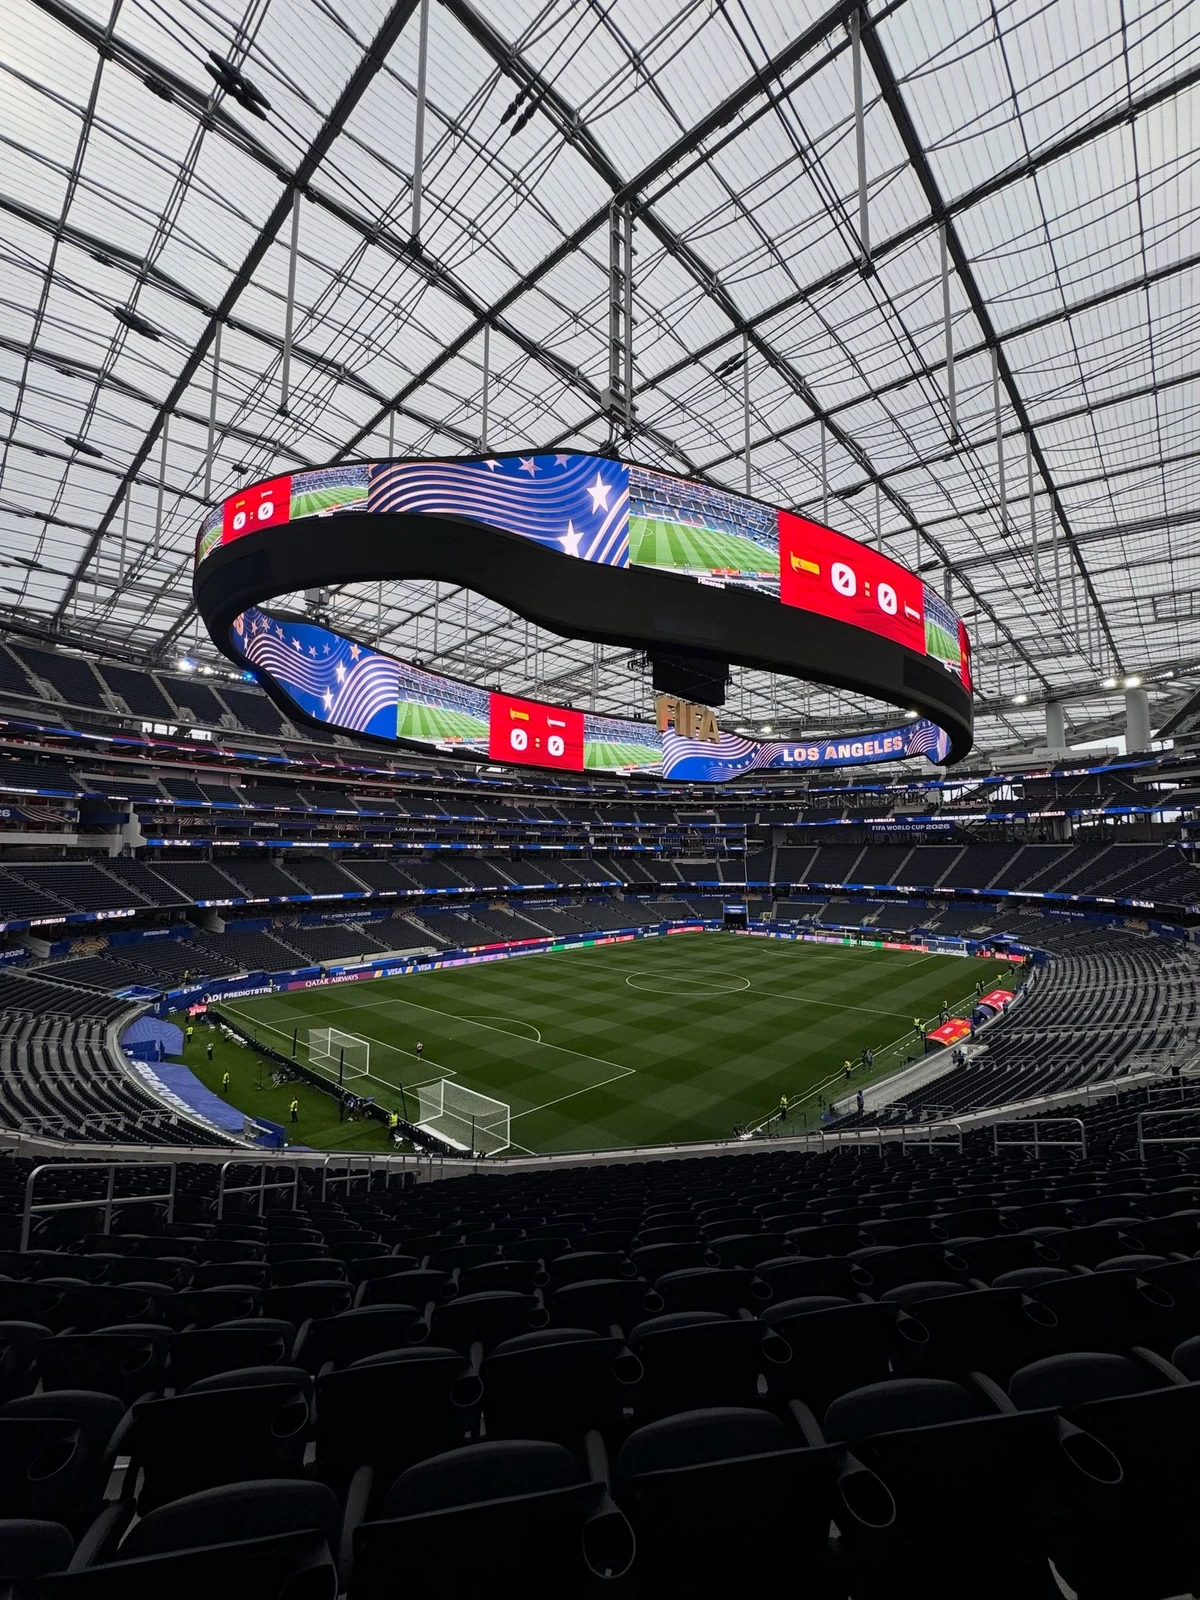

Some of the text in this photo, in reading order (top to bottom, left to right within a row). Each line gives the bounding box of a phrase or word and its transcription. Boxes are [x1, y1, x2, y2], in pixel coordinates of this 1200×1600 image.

[233, 511, 246, 530] 0
[257, 501, 274, 520] 0
[831, 562, 857, 597] 0
[877, 582, 897, 616] 0
[656, 696, 721, 745] FIFA
[510, 728, 528, 751] 0
[547, 735, 565, 757] 0
[783, 735, 903, 762] LOS ANGELES
[4, 948, 25, 959] 2026
[418, 963, 432, 971] VISA
[305, 973, 359, 988] QATAR AIRWAYS
[387, 967, 403, 976] VISA
